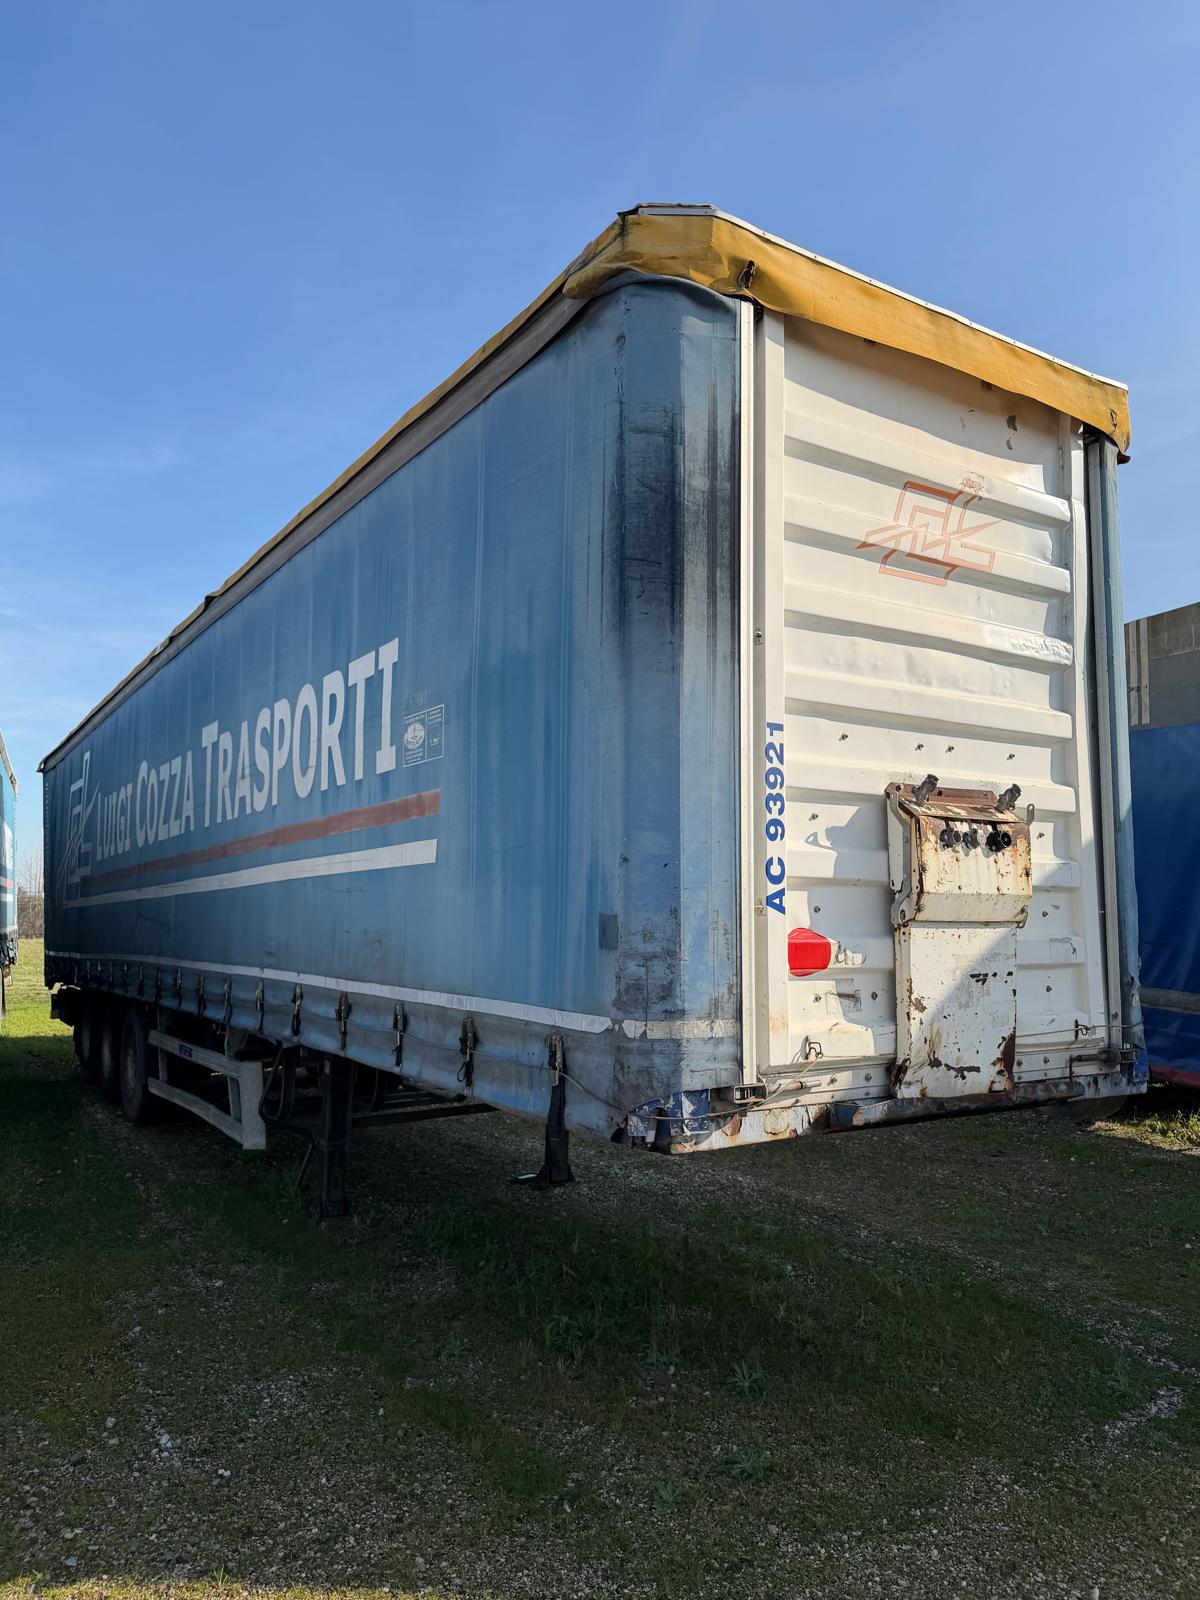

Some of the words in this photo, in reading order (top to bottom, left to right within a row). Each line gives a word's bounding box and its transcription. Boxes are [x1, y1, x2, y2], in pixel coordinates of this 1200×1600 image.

[97, 782, 133, 861] LUIGI
[136, 751, 195, 848] COZZA
[202, 638, 399, 827] TRASPORTI
[765, 722, 785, 841] 93921
[766, 857, 785, 914] AC
